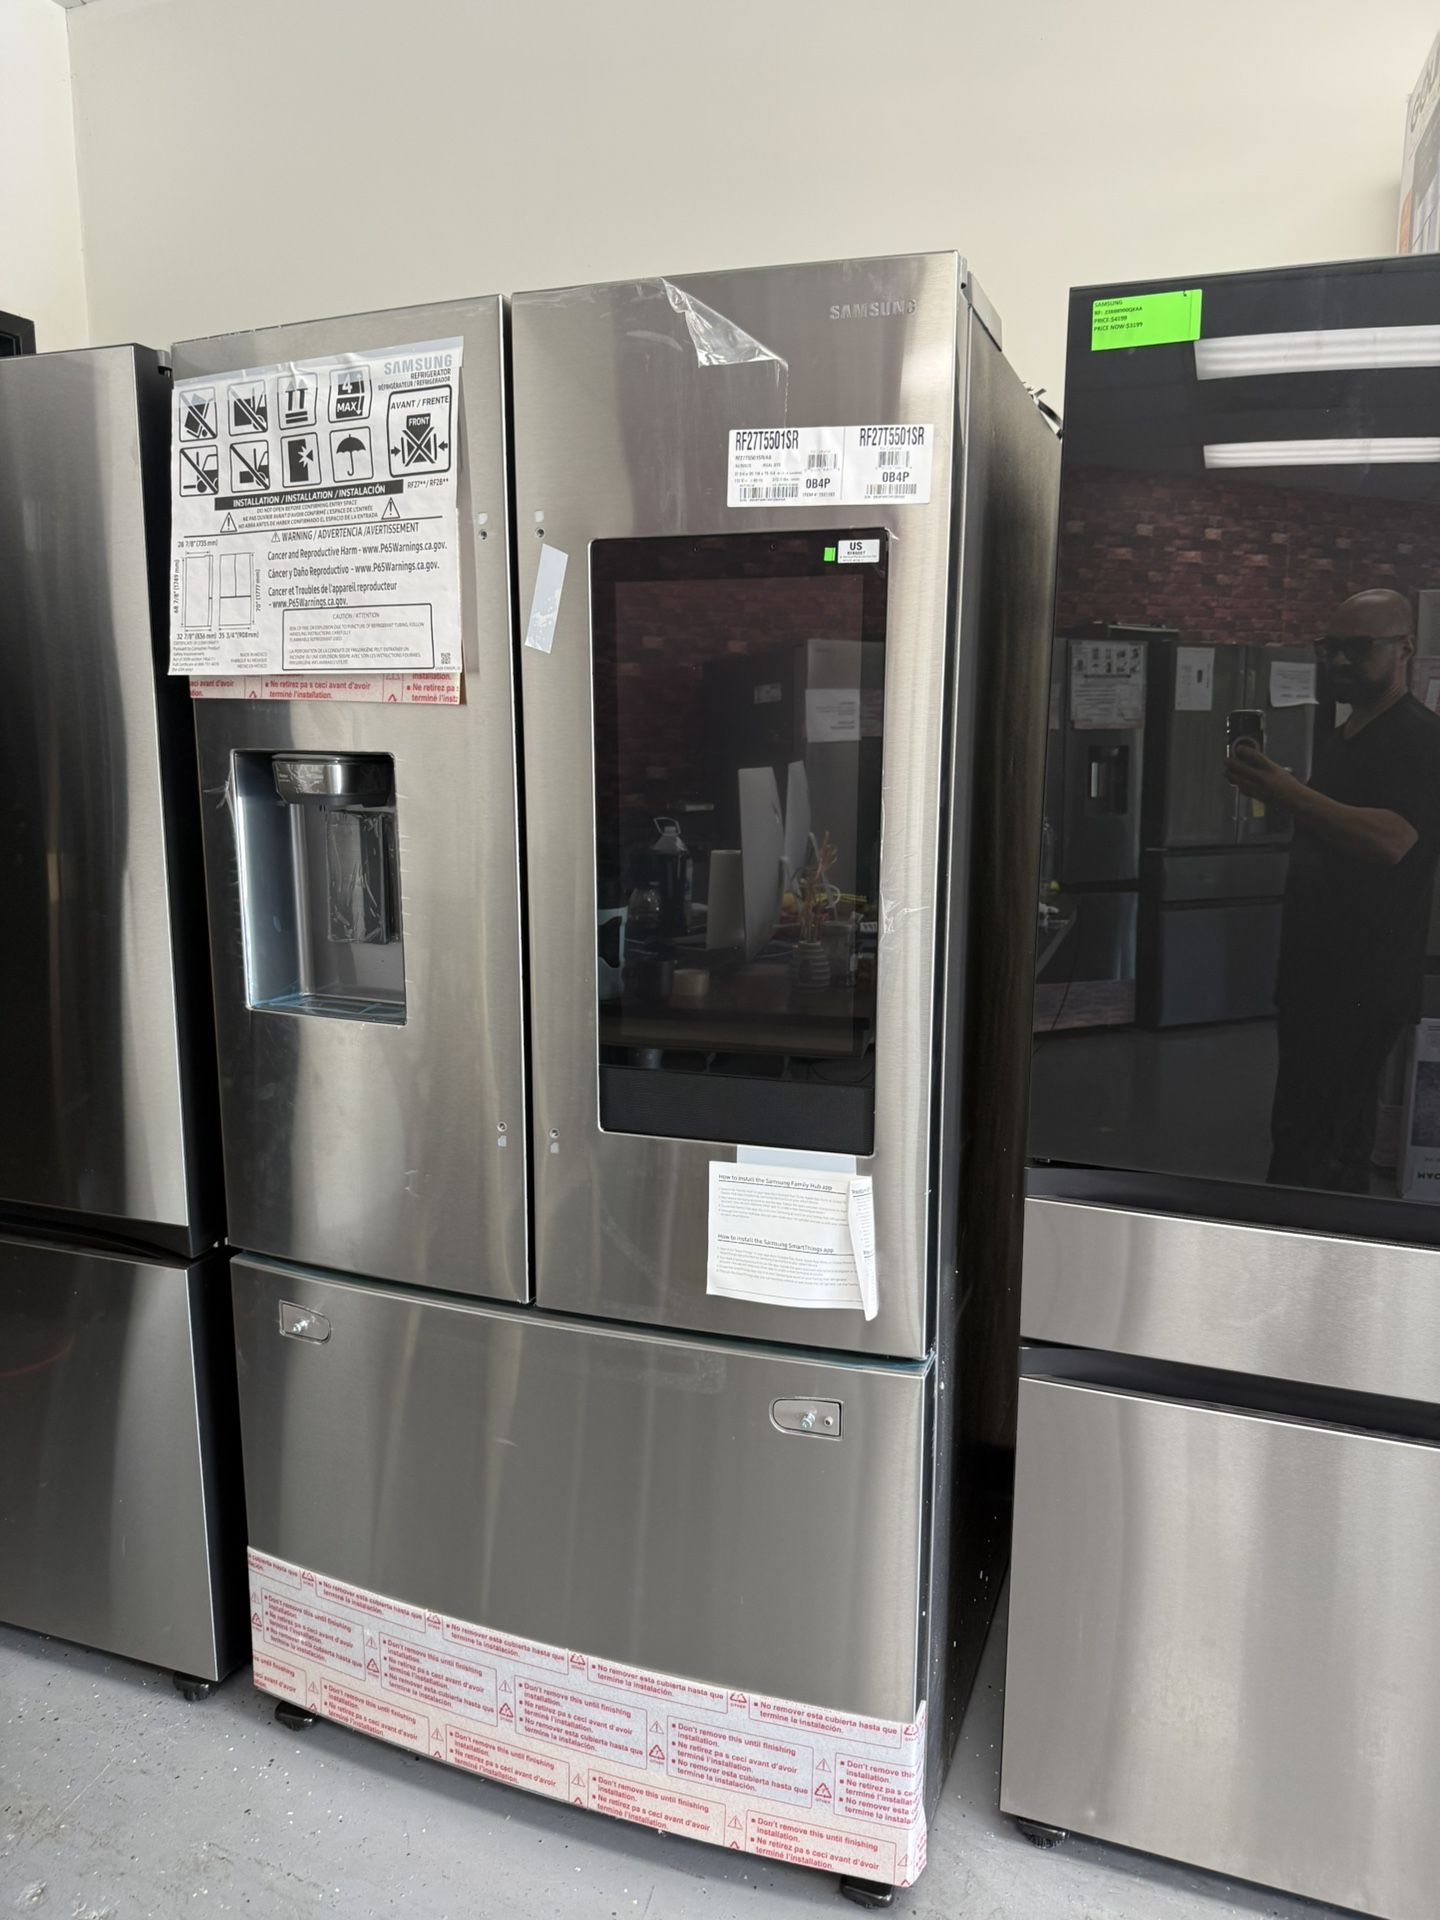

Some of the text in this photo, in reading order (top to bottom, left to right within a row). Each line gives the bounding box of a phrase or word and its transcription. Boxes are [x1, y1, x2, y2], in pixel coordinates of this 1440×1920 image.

[830, 300, 916, 320] SAMSUNG
[384, 354, 452, 375] SAMSUNG
[410, 368, 451, 379] REFRIGERATOR
[342, 376, 353, 394] 4
[336, 400, 356, 413] MAX
[391, 400, 416, 410] AVANT
[422, 395, 449, 406] FRENTE
[408, 415, 430, 427] FRONT
[736, 430, 799, 450] RF27T5501SR
[859, 426, 925, 447] RF27T5501SR
[882, 472, 910, 483] 0B4P
[233, 494, 280, 508] INSTALLATION
[282, 530, 312, 542] WARNING
[318, 526, 361, 539] ADVERTENCIA
[268, 552, 286, 561] Cancer
[287, 549, 300, 559] and
[301, 546, 339, 561] Reproductive
[341, 545, 358, 554] Harm
[849, 541, 863, 551] US
[268, 570, 286, 579] Cáncer
[287, 571, 292, 580] y
[294, 568, 308, 577] Daño
[310, 565, 349, 578] Reproductivo
[268, 581, 397, 597] Cancer et Troubles de l'appareil reproducteur
[412, 694, 438, 702] terminé
[766, 1179, 790, 1187] Samsung
[791, 1181, 809, 1189] Family
[764, 1239, 788, 1249] Samsung
[789, 1243, 821, 1253] SmartThings
[760, 1710, 788, 1722] termine
[760, 1701, 771, 1710] No
[773, 1706, 804, 1716] remover
[807, 1712, 822, 1720] esta
[825, 1716, 857, 1727] cubierta
[859, 1721, 880, 1732] hasta
[678, 1732, 720, 1747] installation.
[678, 1723, 796, 1757] Don't remove this until finishing
[678, 1750, 705, 1762] terminé
[678, 1741, 688, 1750] Ne
[690, 1745, 712, 1755] retirez
[715, 1751, 725, 1759] pa
[732, 1755, 747, 1763] ceci
[749, 1759, 769, 1767] avant
[771, 1761, 798, 1773] d'avoir
[678, 1769, 705, 1780] termine
[678, 1760, 688, 1768] No
[690, 1764, 718, 1774] remover
[739, 1774, 769, 1785] cubierta
[772, 1780, 792, 1790] hasta
[794, 1786, 808, 1794] que
[757, 1827, 800, 1842] installation.
[758, 1818, 878, 1852] Don't remove this until finishing
[756, 1846, 784, 1859] terminé
[756, 1836, 767, 1846] Ne
[769, 1840, 792, 1851] retirez
[812, 1851, 828, 1859] ceci
[830, 1855, 851, 1864] avant
[853, 1857, 879, 1870] d'avoir
